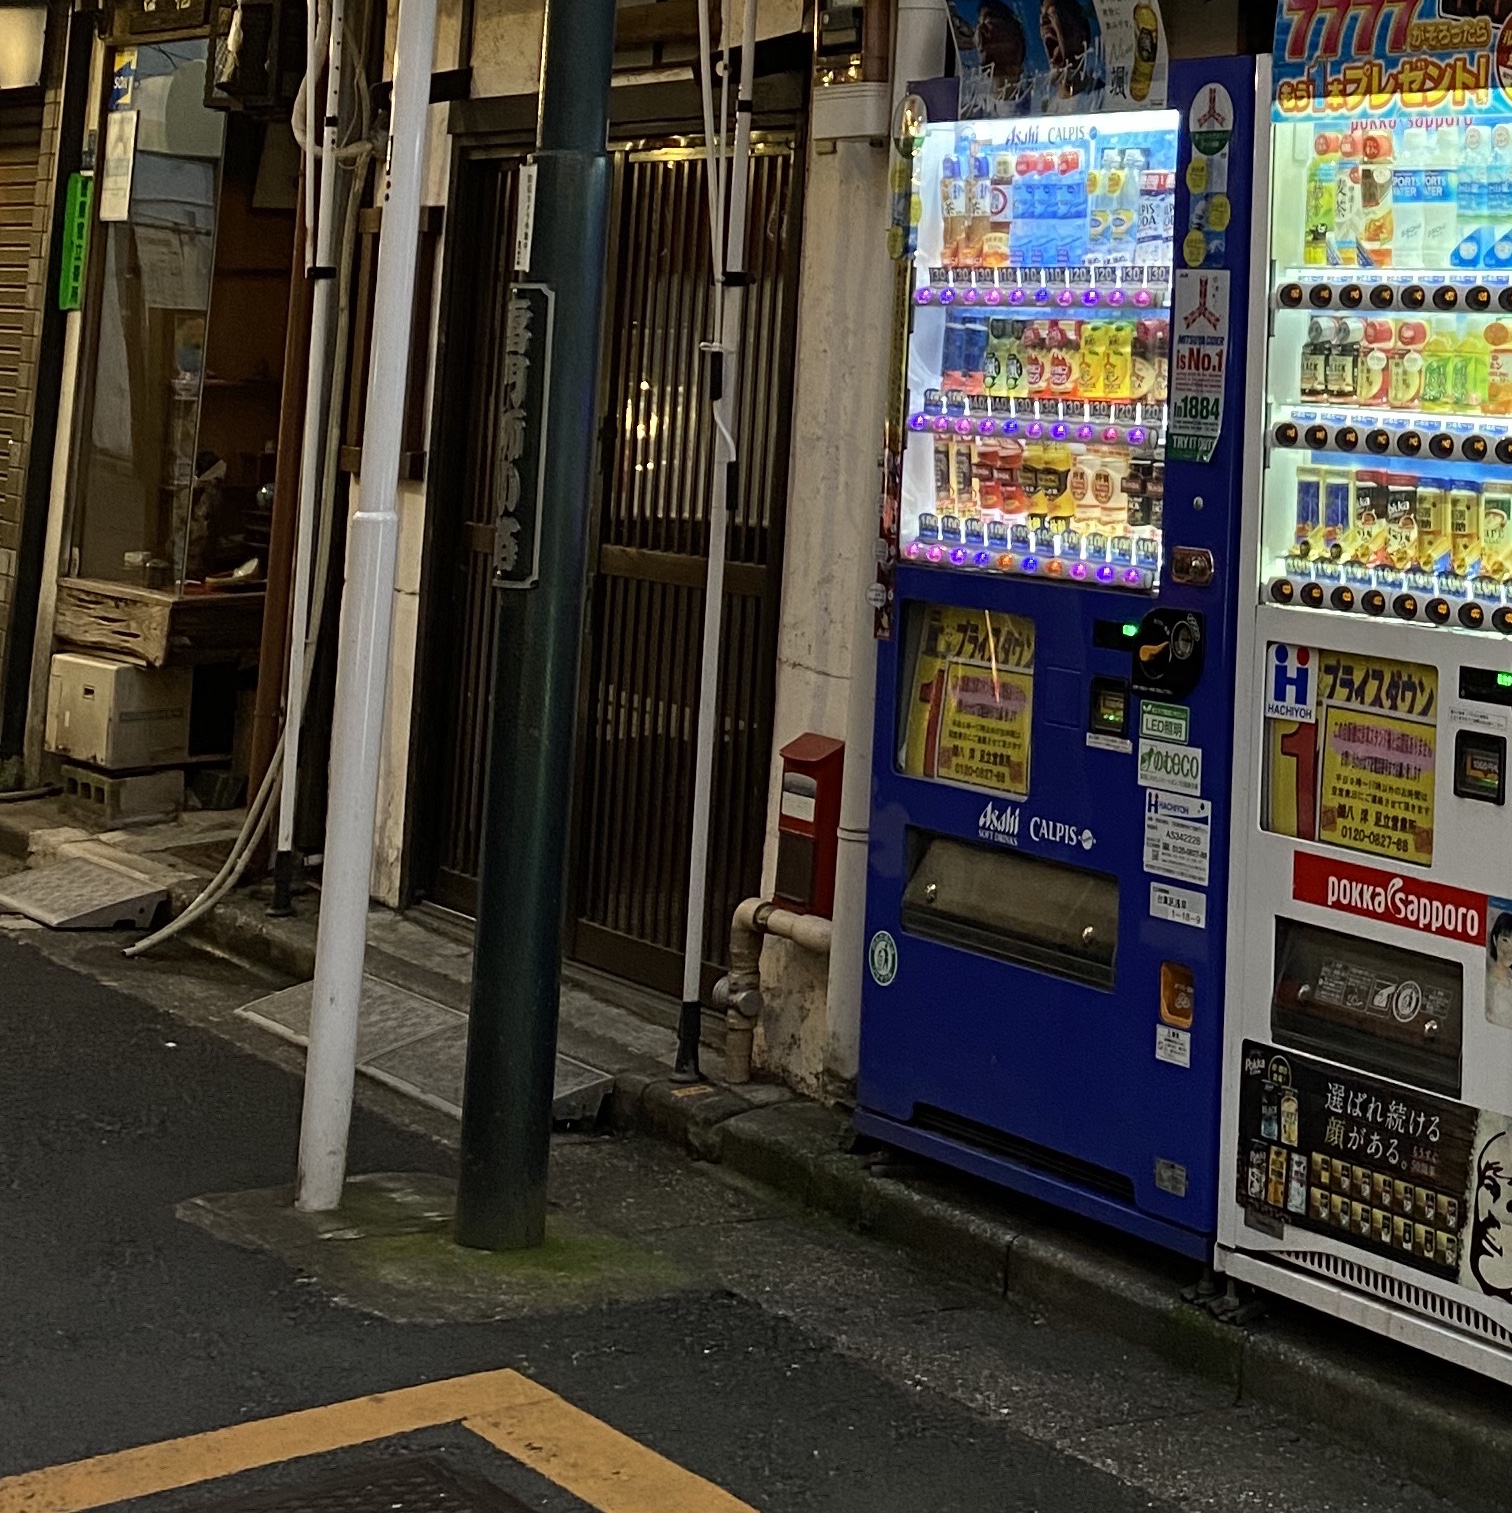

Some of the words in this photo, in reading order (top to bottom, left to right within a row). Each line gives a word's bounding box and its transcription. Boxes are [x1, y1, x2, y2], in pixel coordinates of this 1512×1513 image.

[1048, 125, 1085, 145] CALPIS
[1176, 349, 1187, 370] is
[1187, 348, 1224, 372] No.1
[1182, 395, 1220, 421] 1884
[1173, 435, 1188, 449] TRY
[1267, 702, 1312, 720] HACHIYOH
[978, 801, 1020, 835] Asahi
[1030, 816, 1077, 846] CALPIS
[1327, 875, 1385, 914] pokka
[1394, 889, 1479, 937] sapporo
[1324, 1082, 1441, 1143] 選ばれ続ける
[1324, 1116, 1408, 1171] 顔がある。
